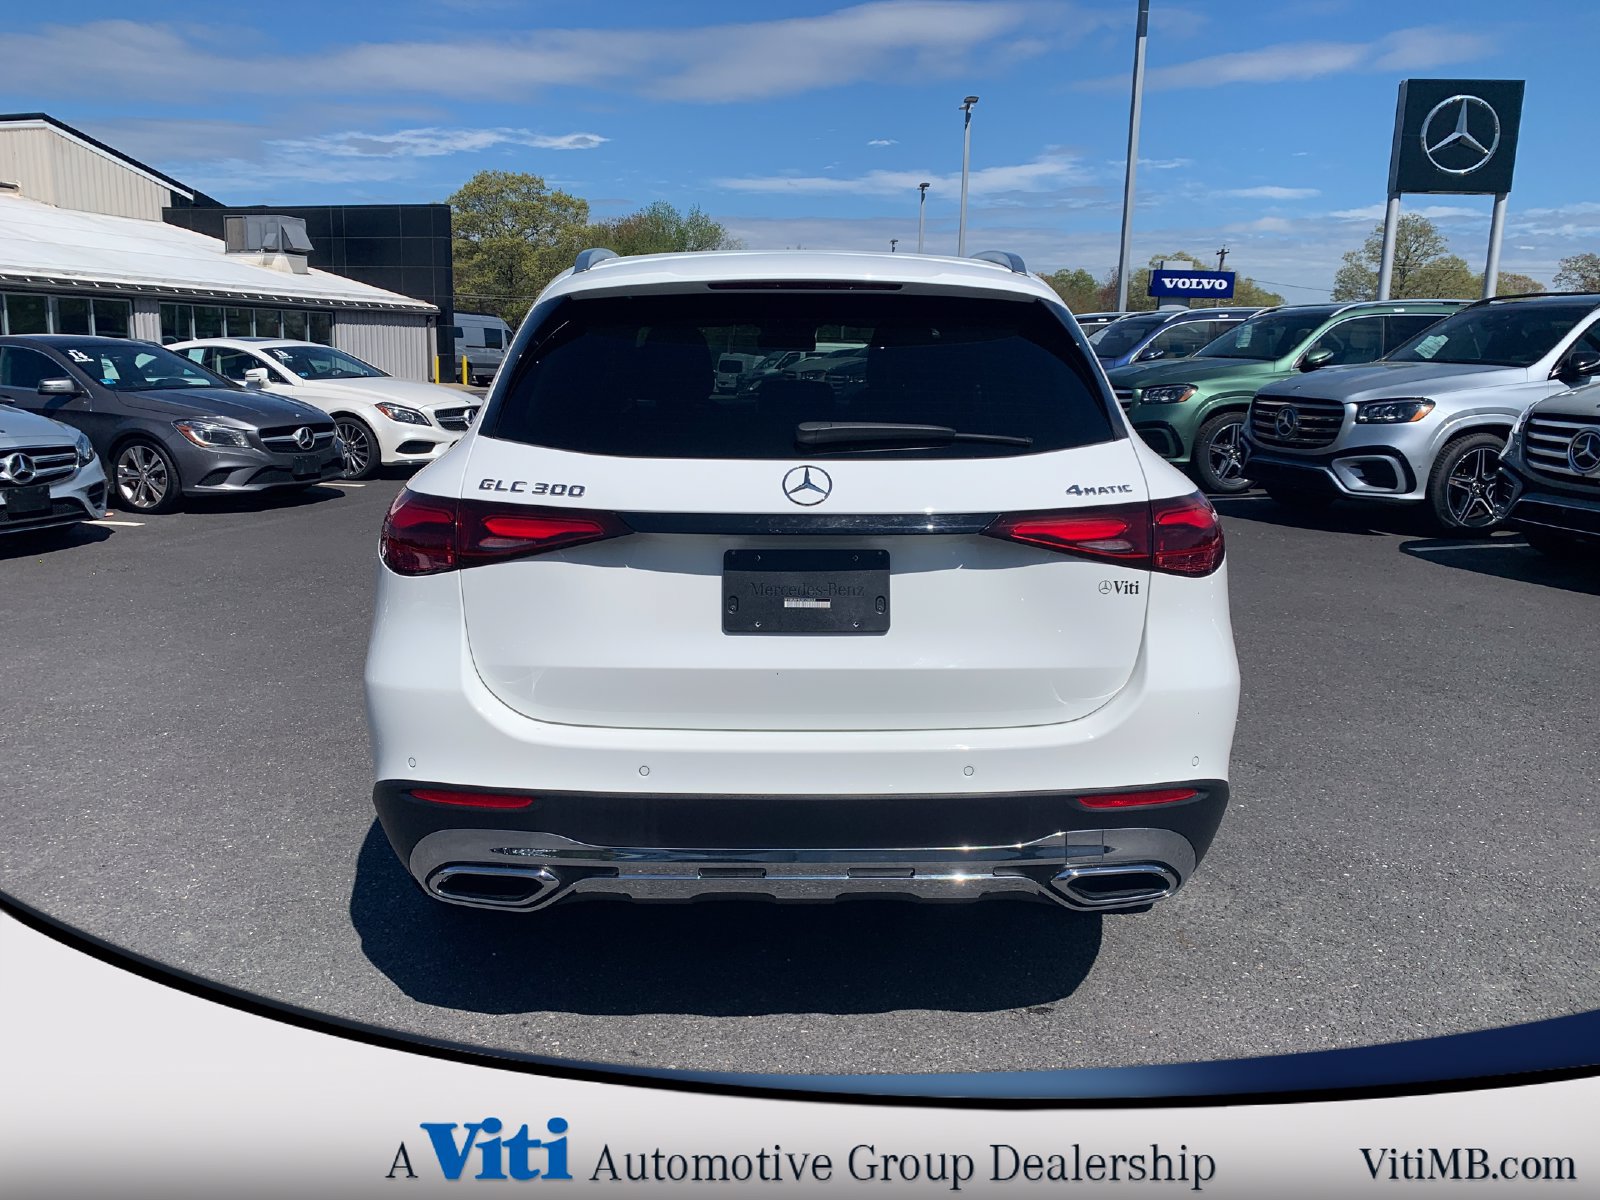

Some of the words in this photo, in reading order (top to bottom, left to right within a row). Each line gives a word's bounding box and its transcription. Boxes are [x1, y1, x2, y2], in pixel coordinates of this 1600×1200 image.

[1161, 278, 1228, 290] VOLVO
[478, 478, 528, 493] GLC
[531, 482, 586, 498] 300
[1065, 484, 1133, 497] 4MATIC
[750, 582, 865, 597] Mercedes-Benz
[1113, 580, 1140, 595] Viti
